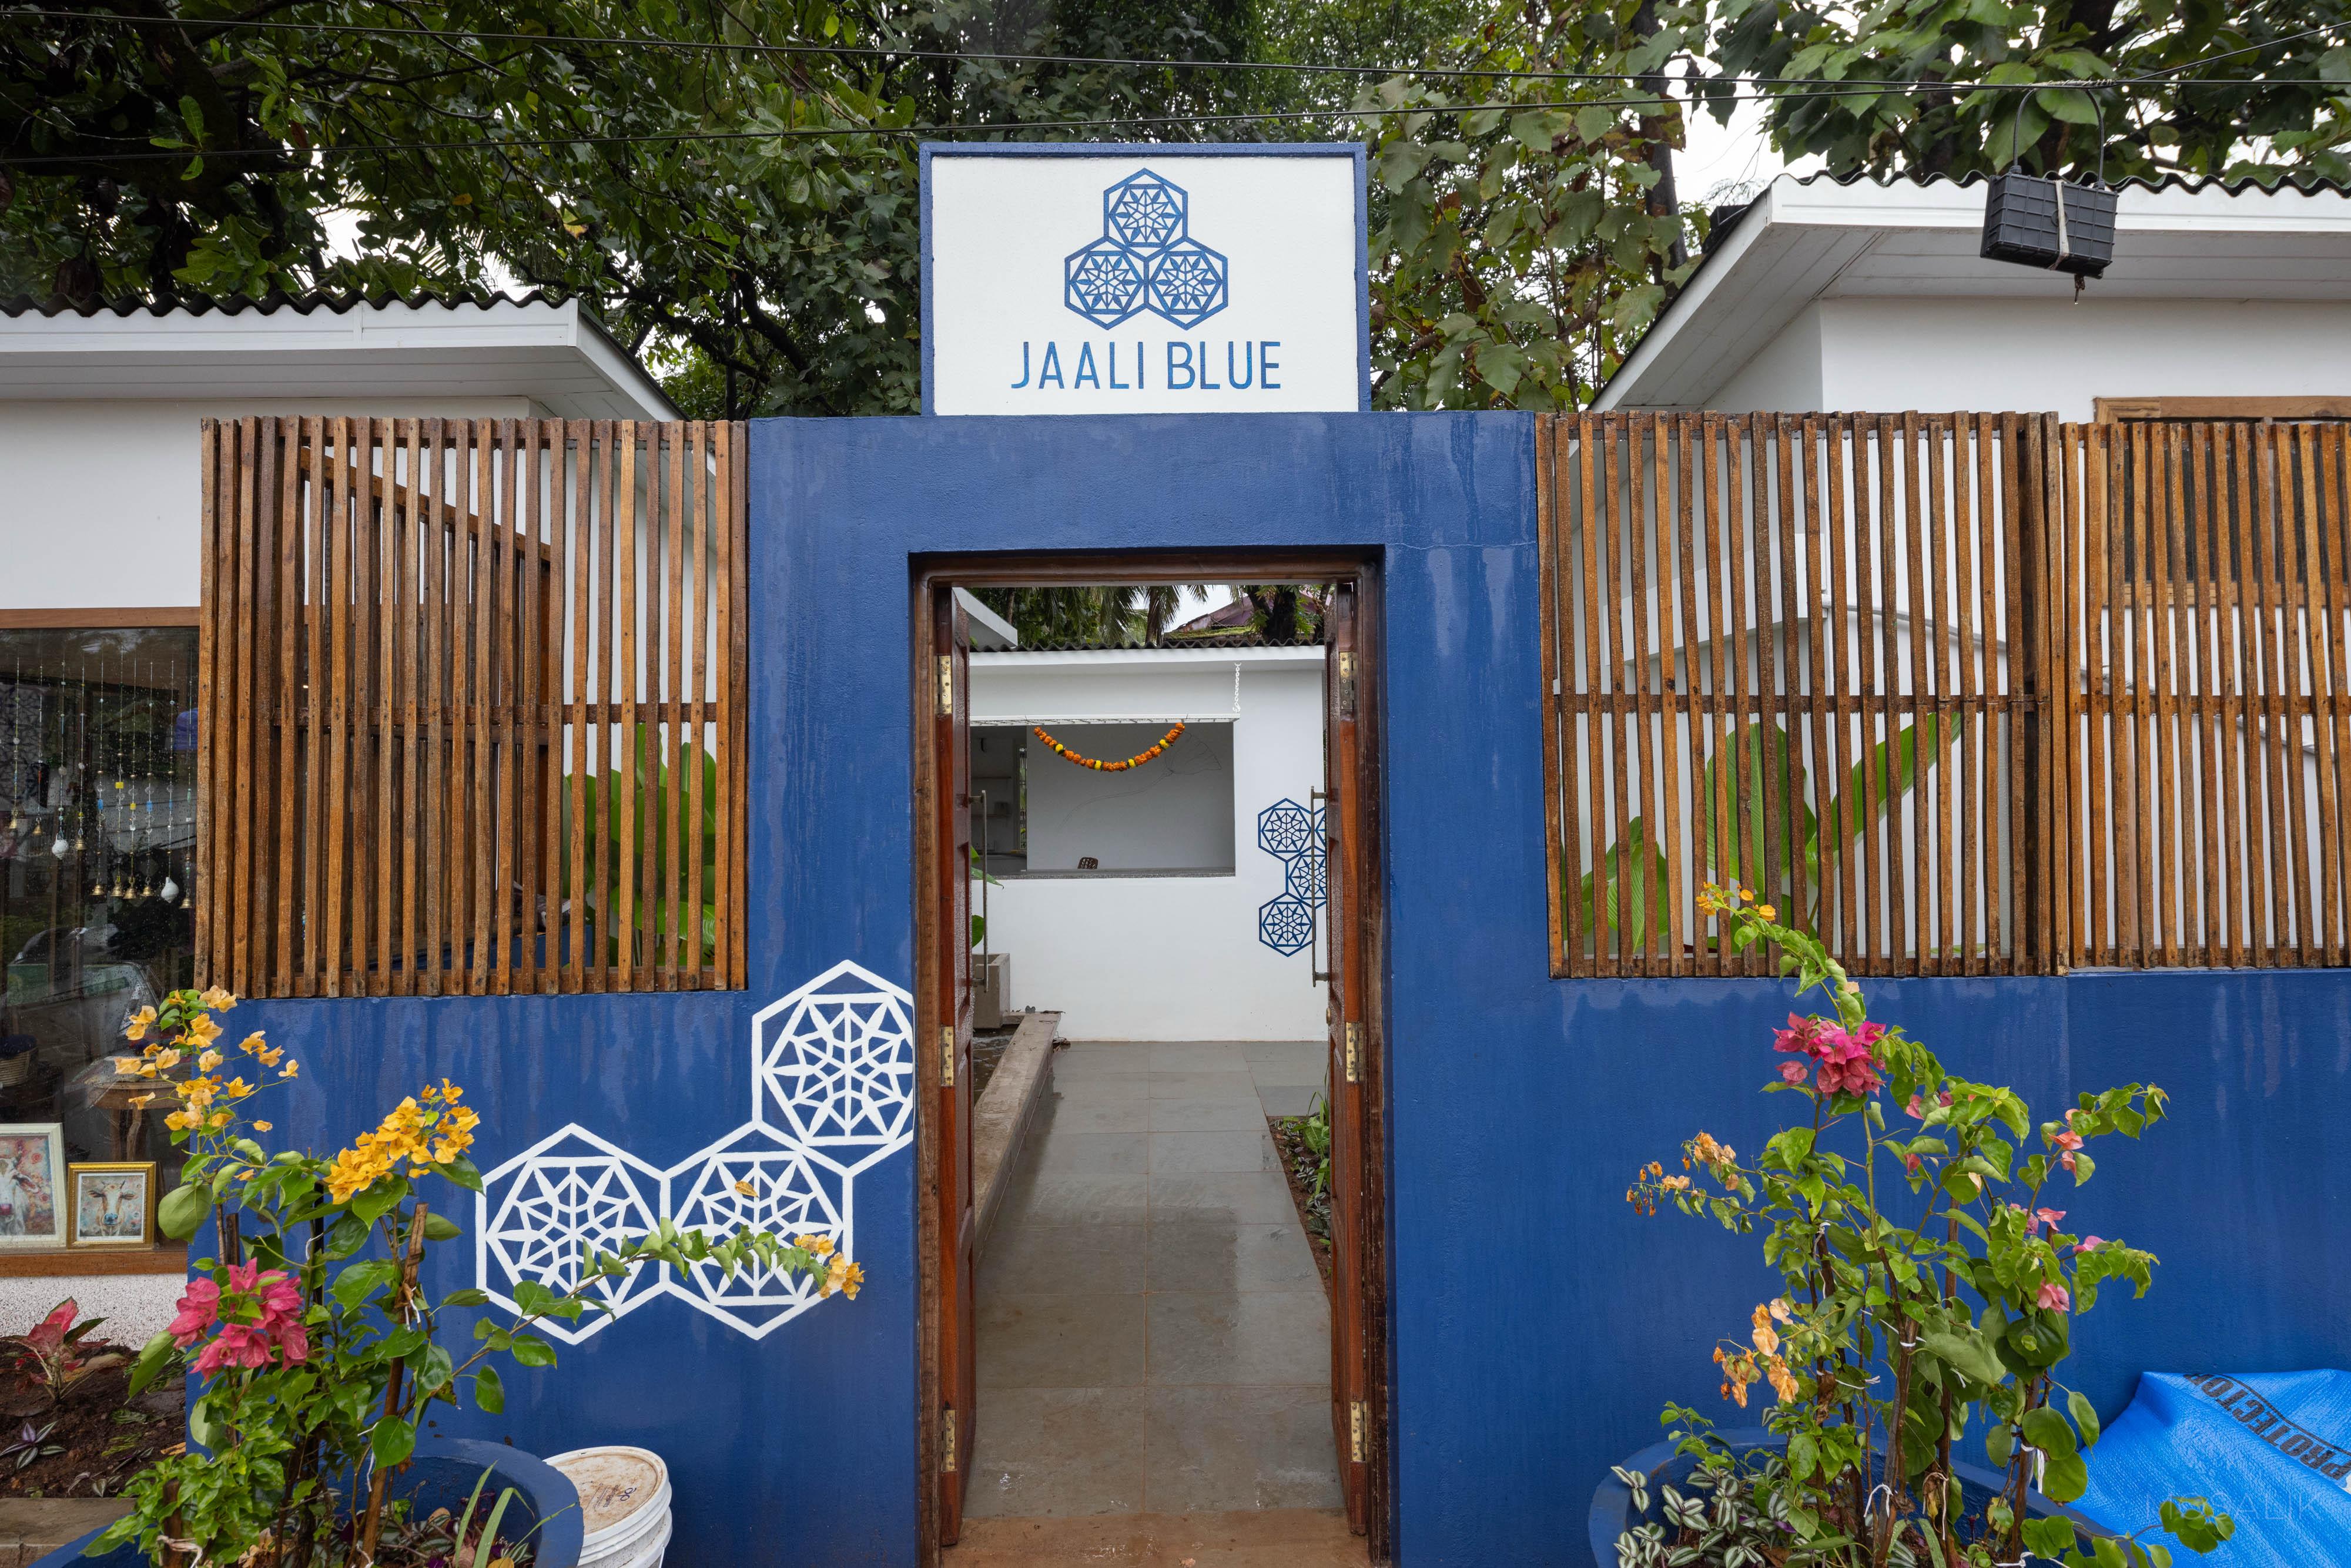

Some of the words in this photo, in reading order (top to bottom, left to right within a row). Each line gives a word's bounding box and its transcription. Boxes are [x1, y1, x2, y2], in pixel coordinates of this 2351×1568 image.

[1011, 341, 1144, 389] JAALI
[1167, 341, 1281, 389] BLUE
[2183, 1373, 2351, 1480] PROTECTOR
